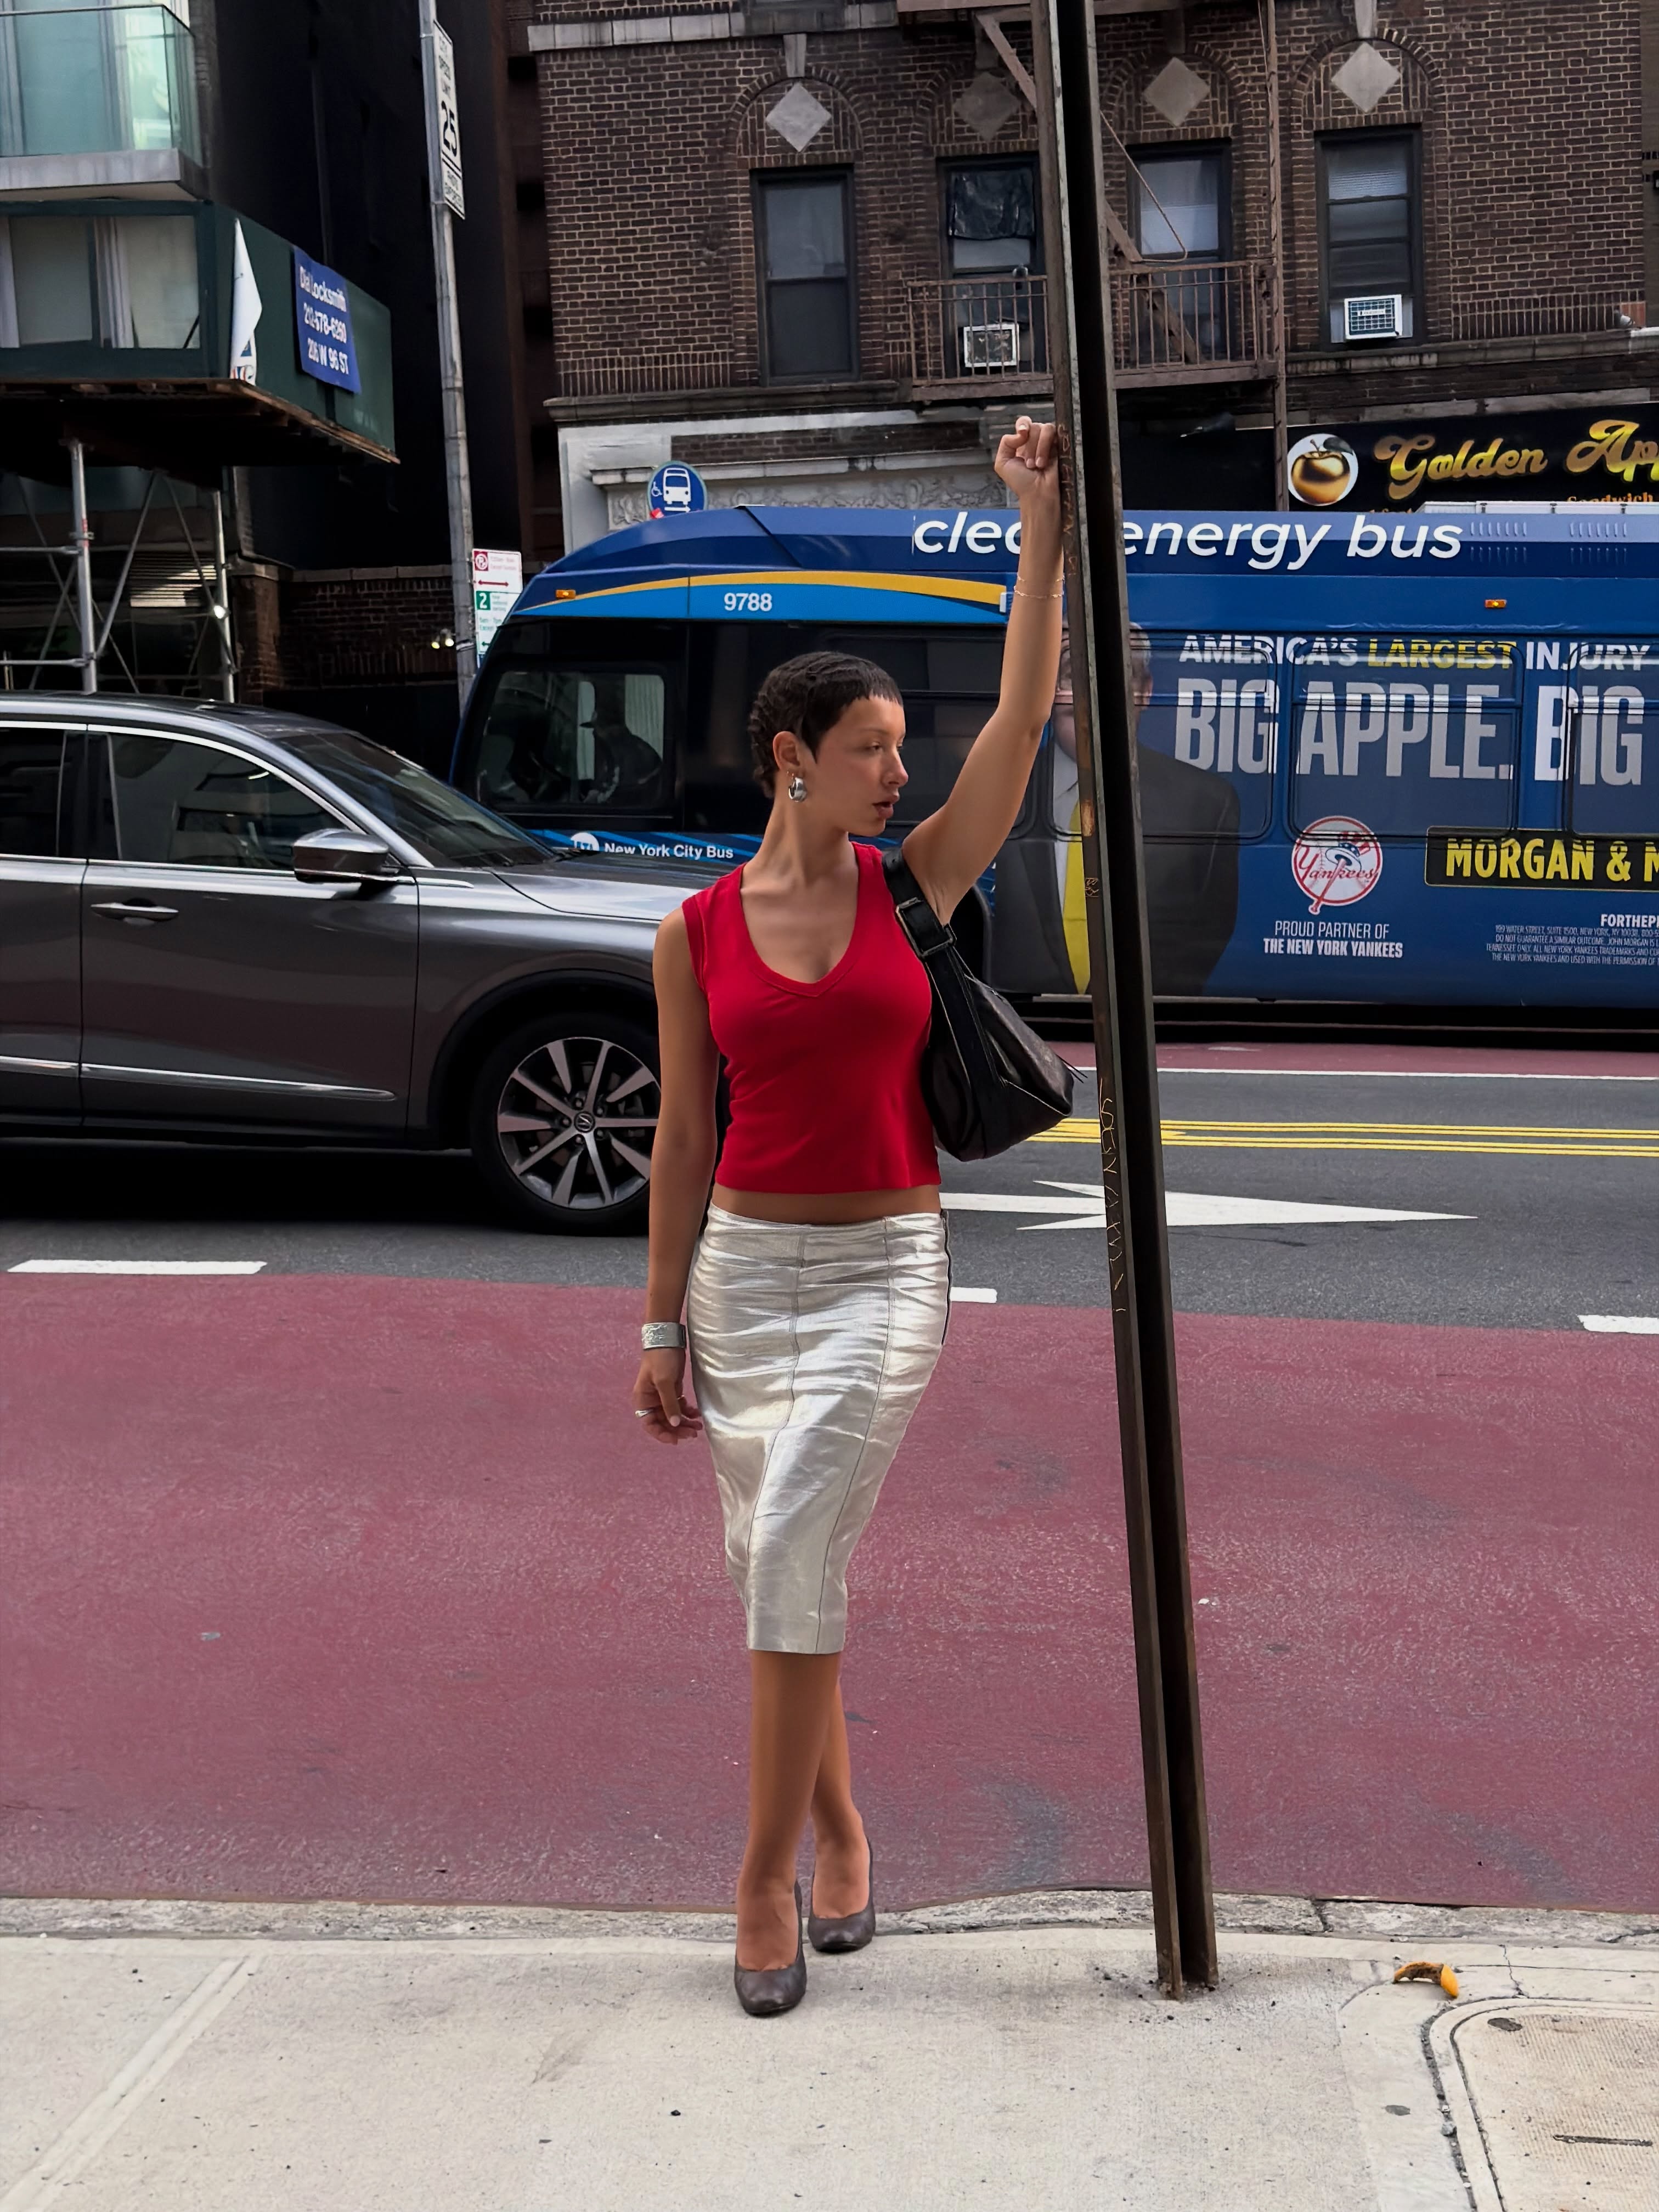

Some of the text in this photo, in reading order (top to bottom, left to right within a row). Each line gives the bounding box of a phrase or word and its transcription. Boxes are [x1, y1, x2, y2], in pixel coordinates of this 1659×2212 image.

[442, 100, 457, 157] 25
[311, 276, 347, 312] Locksmith
[318, 343, 328, 366] W
[328, 347, 340, 371] 96
[338, 351, 349, 375] ST
[1373, 419, 1659, 500] Golden Ap
[914, 511, 1022, 554] cle
[1346, 515, 1464, 559] bus
[479, 592, 488, 609] 2
[724, 592, 772, 612] 9788
[1179, 635, 1650, 672] AMERICA'S LARGEST INJURY
[1175, 678, 1645, 786] BIG APPLE. BIG
[605, 842, 734, 860] New York City Bus
[1295, 845, 1379, 883] Yankees
[1446, 838, 1595, 881] MORGAN
[1606, 840, 1631, 882] &
[1274, 921, 1390, 939] PROUD PARTNER OF
[1496, 934, 1504, 943] DO
[1505, 934, 1515, 943] NOT
[1517, 935, 1548, 944] GUARANTEE
[1554, 935, 1576, 944] SIMILAR
[1607, 938, 1623, 946] JOHN
[1623, 938, 1649, 946] MORGAN
[1505, 925, 1525, 934] WATER
[1579, 927, 1594, 935] NEW
[1263, 938, 1403, 958] THE NEW YORK YANKEES
[1486, 943, 1516, 952] TENNESSEE
[1533, 944, 1543, 953] ALL
[1544, 945, 1558, 953] NEW
[1558, 945, 1573, 954] YORK
[1573, 945, 1598, 955] YANKEES
[1599, 946, 1636, 956] TRADEMARKS
[1635, 947, 1649, 956] AND
[1492, 952, 1502, 961] THE
[1503, 953, 1516, 962] NEW
[1517, 953, 1532, 962] YORK
[1533, 954, 1558, 963] YANKEES
[1557, 955, 1570, 963] AND
[1570, 955, 1585, 964] USED
[1585, 956, 1601, 964] WITH
[1612, 956, 1647, 965] PERMISSION
[1647, 957, 1656, 966] OF
